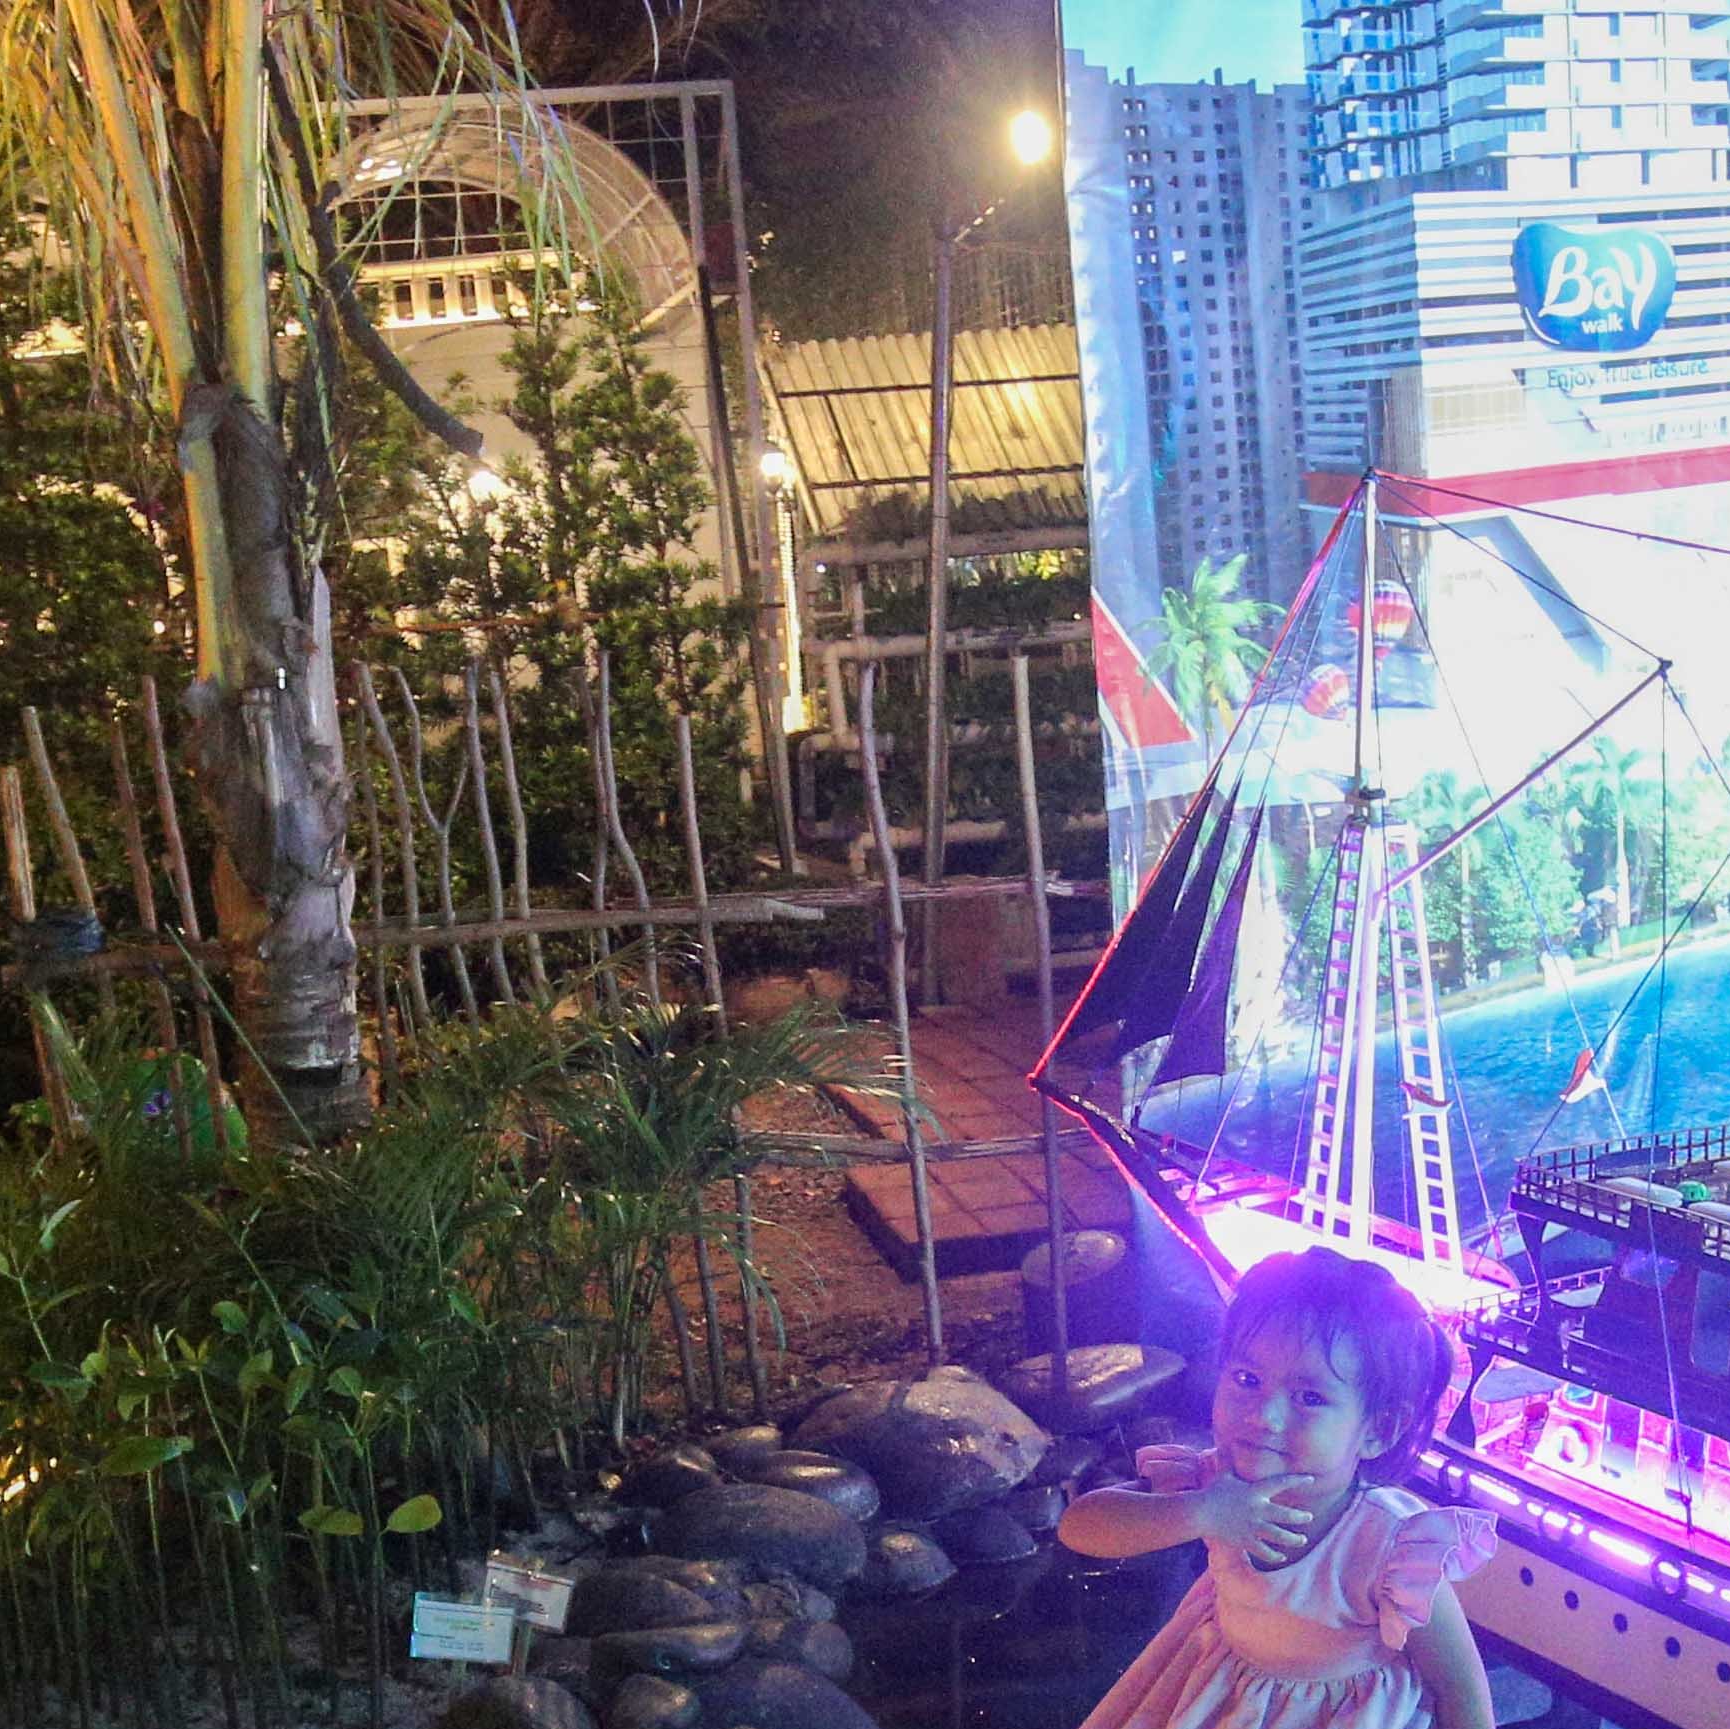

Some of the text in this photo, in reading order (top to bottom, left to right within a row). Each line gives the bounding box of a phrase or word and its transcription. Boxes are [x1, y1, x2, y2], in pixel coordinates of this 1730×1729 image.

[1538, 243, 1657, 331] Bay
[1582, 312, 1623, 334] walk
[1548, 369, 1594, 388] Enjoy
